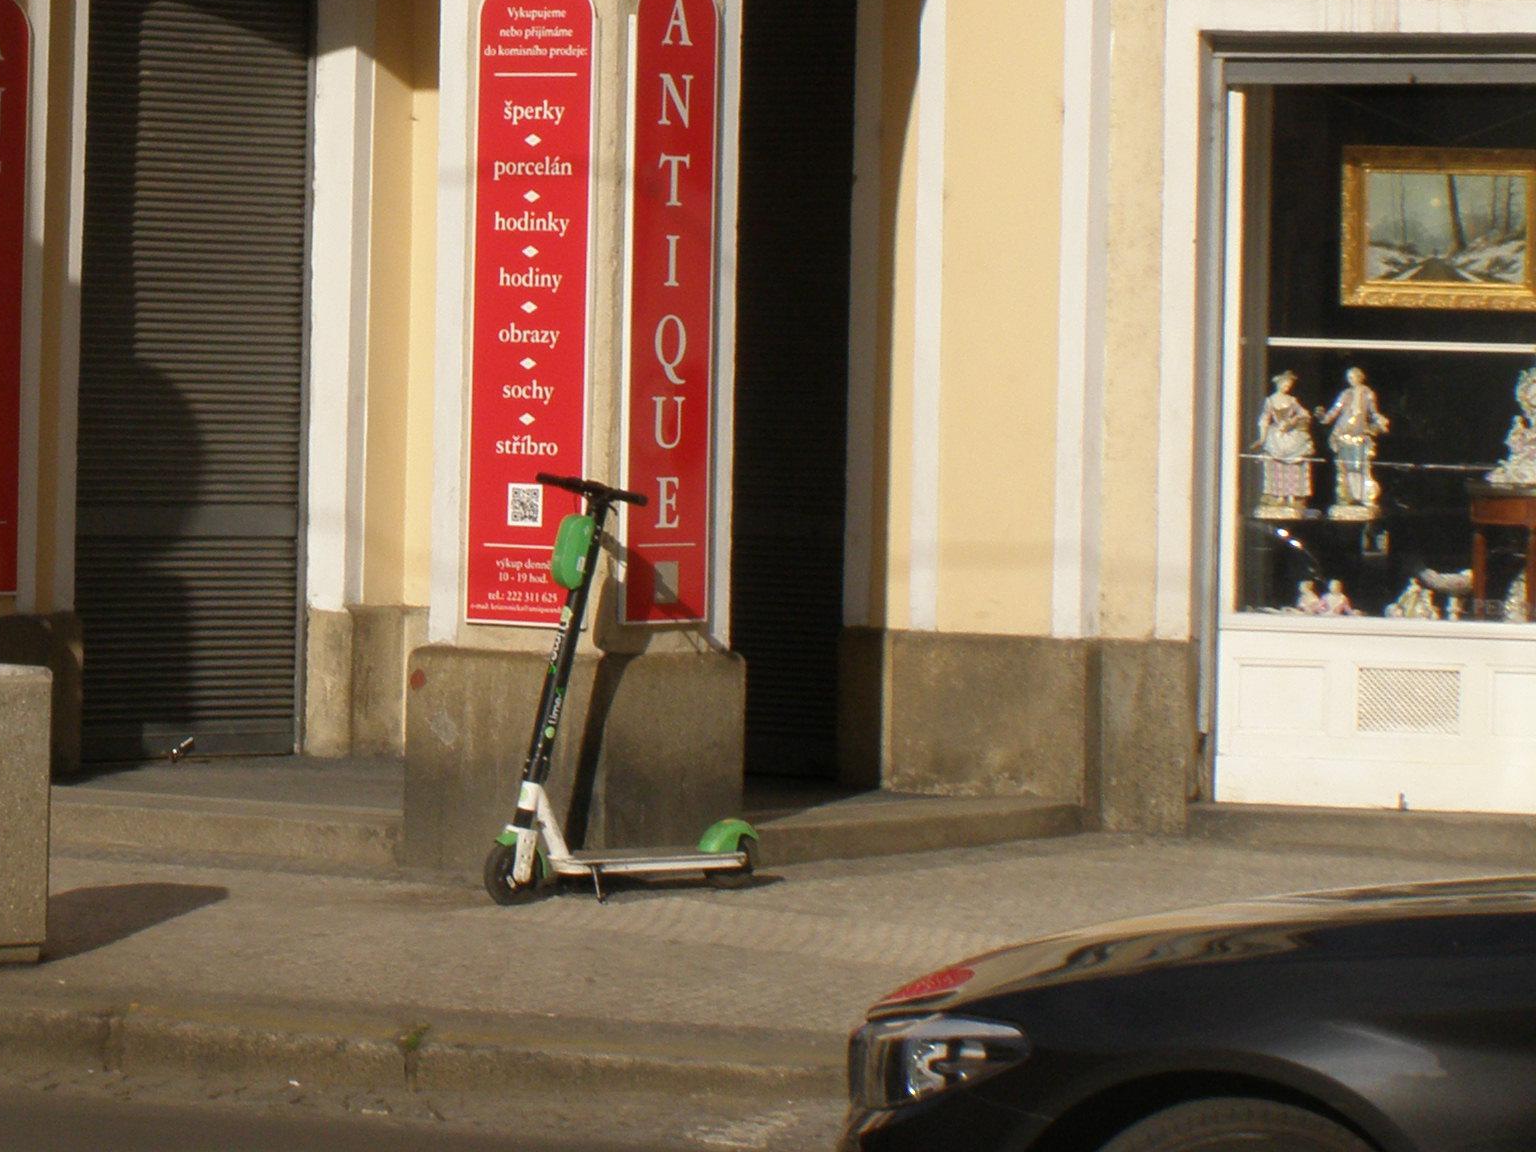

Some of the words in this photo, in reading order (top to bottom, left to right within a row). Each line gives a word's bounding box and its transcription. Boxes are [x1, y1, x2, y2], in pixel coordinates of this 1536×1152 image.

[507, 6, 567, 21] Vykupujeme
[499, 26, 523, 37] nebo
[483, 44, 497, 56] do
[497, 44, 547, 56] komisního
[548, 44, 588, 59] prodeje:
[503, 100, 565, 125] šperky
[493, 156, 573, 181] porcelán
[494, 211, 570, 237] hodinky
[499, 267, 563, 293] hodiny
[498, 323, 560, 348] obrazy
[502, 380, 554, 405] sochy
[495, 435, 558, 456] stříbro
[496, 557, 523, 571] výkup
[499, 572, 509, 581] 10
[517, 573, 528, 582] 19
[529, 573, 549, 584] hod.
[506, 591, 522, 602] 222
[541, 592, 558, 603] 625
